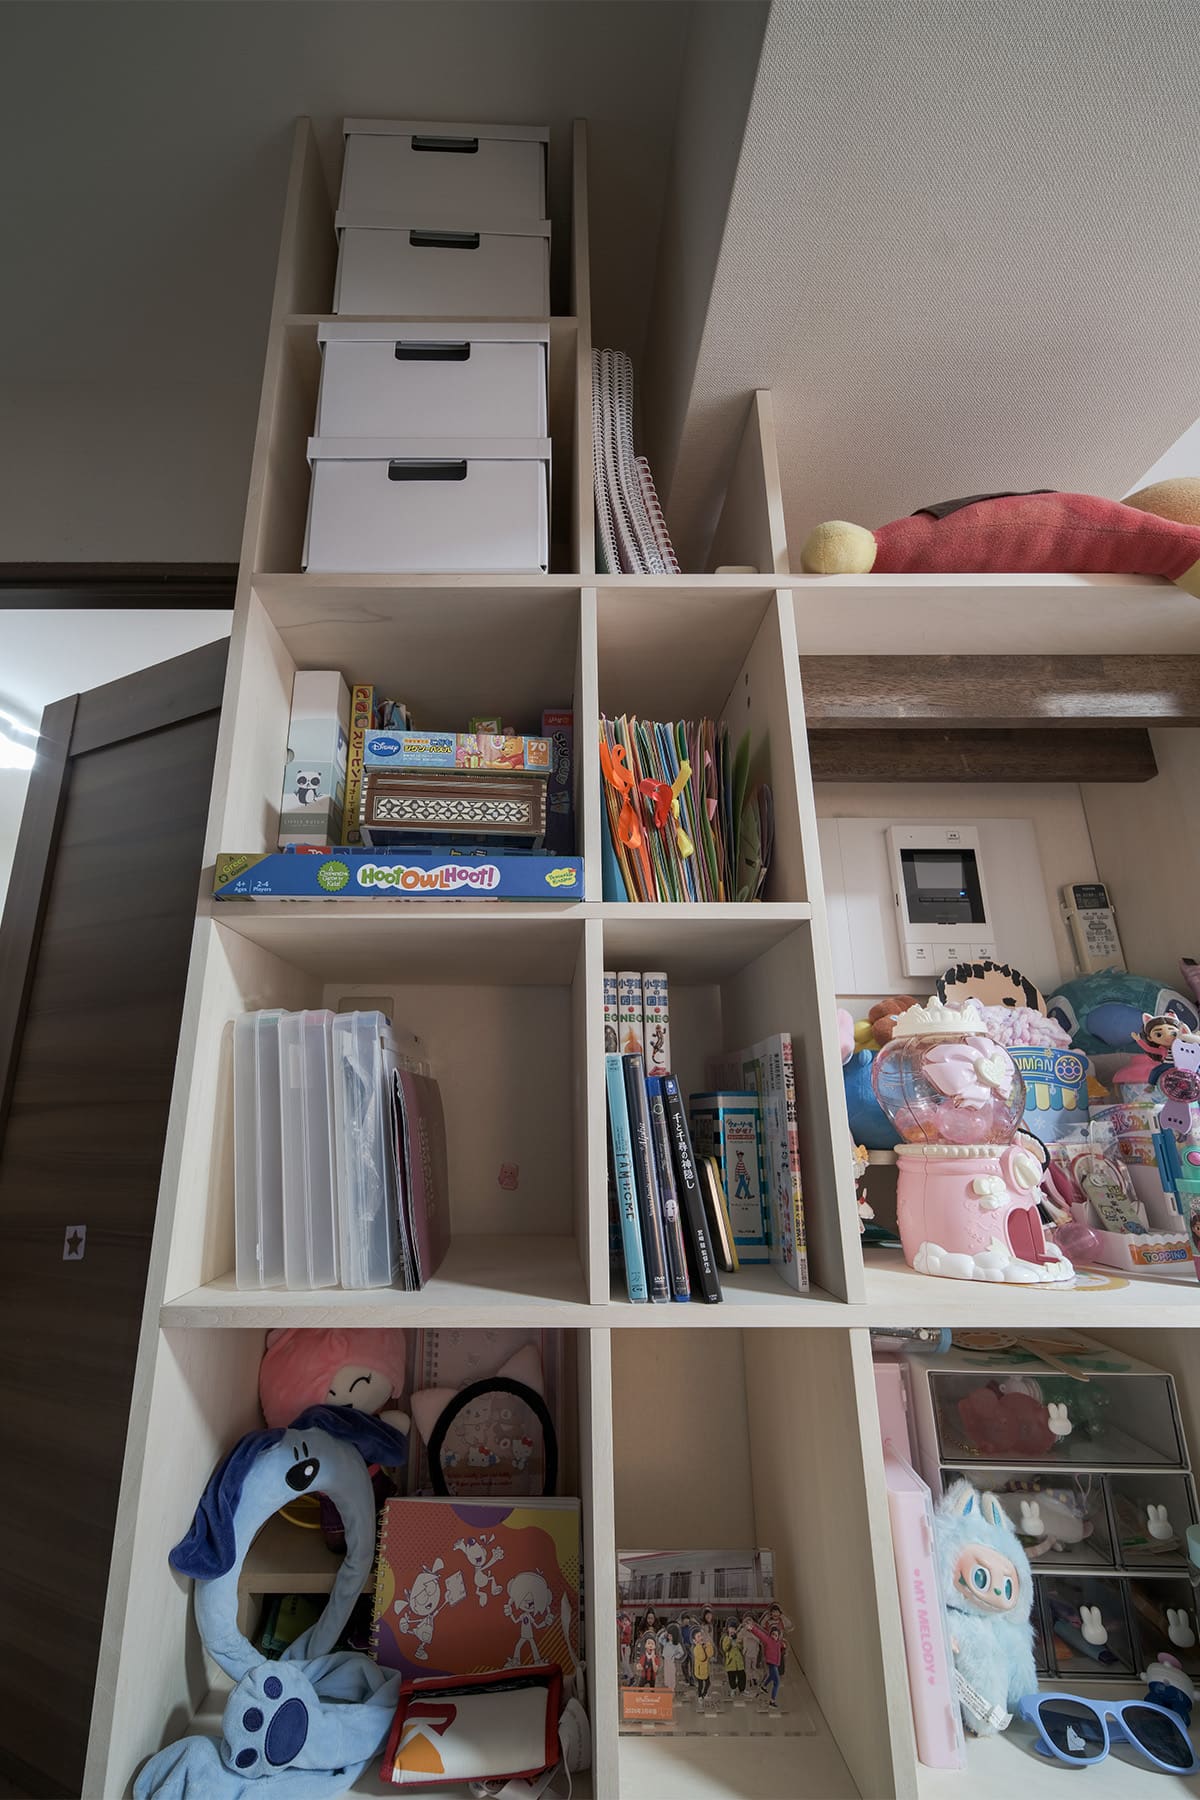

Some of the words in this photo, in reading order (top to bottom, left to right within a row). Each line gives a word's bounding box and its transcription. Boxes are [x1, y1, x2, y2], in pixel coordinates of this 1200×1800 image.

[371, 741, 399, 753] Disney
[530, 742, 547, 752] 70
[222, 855, 248, 873] Green
[620, 1013, 643, 1022] NEO
[646, 1014, 670, 1023] NEO
[672, 1112, 695, 1189] 千と千尋の神隠し
[1142, 1249, 1188, 1262] TOPPING
[914, 1580, 927, 1605] MY
[917, 1609, 936, 1674] MELODY
